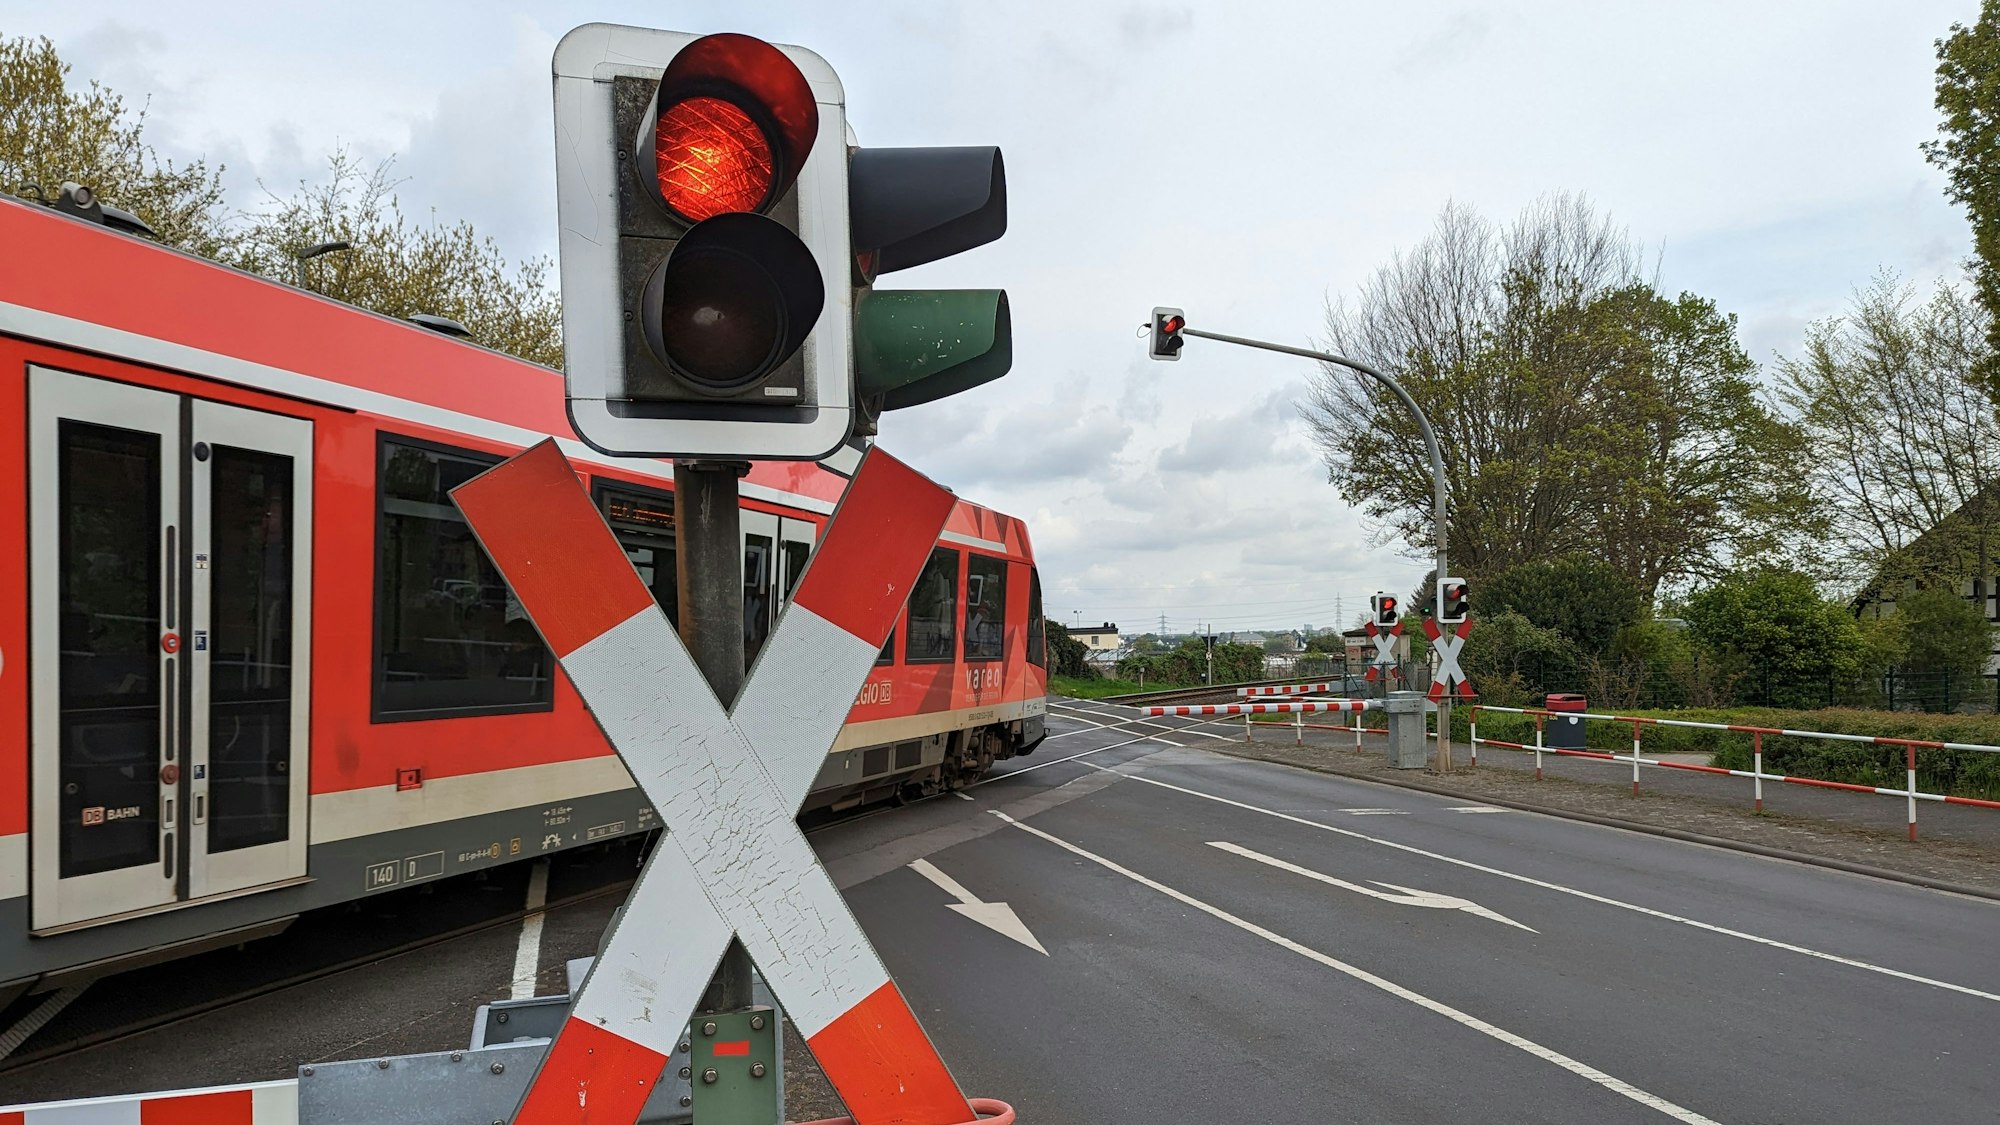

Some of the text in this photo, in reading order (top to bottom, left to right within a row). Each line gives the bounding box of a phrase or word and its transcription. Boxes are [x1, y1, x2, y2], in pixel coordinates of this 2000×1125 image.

[966, 668, 1000, 689] vareo
[854, 680, 891, 705] GIO DB
[83, 806, 140, 825] DB BAHN
[373, 866, 393, 885] 140
[408, 861, 416, 877] D
